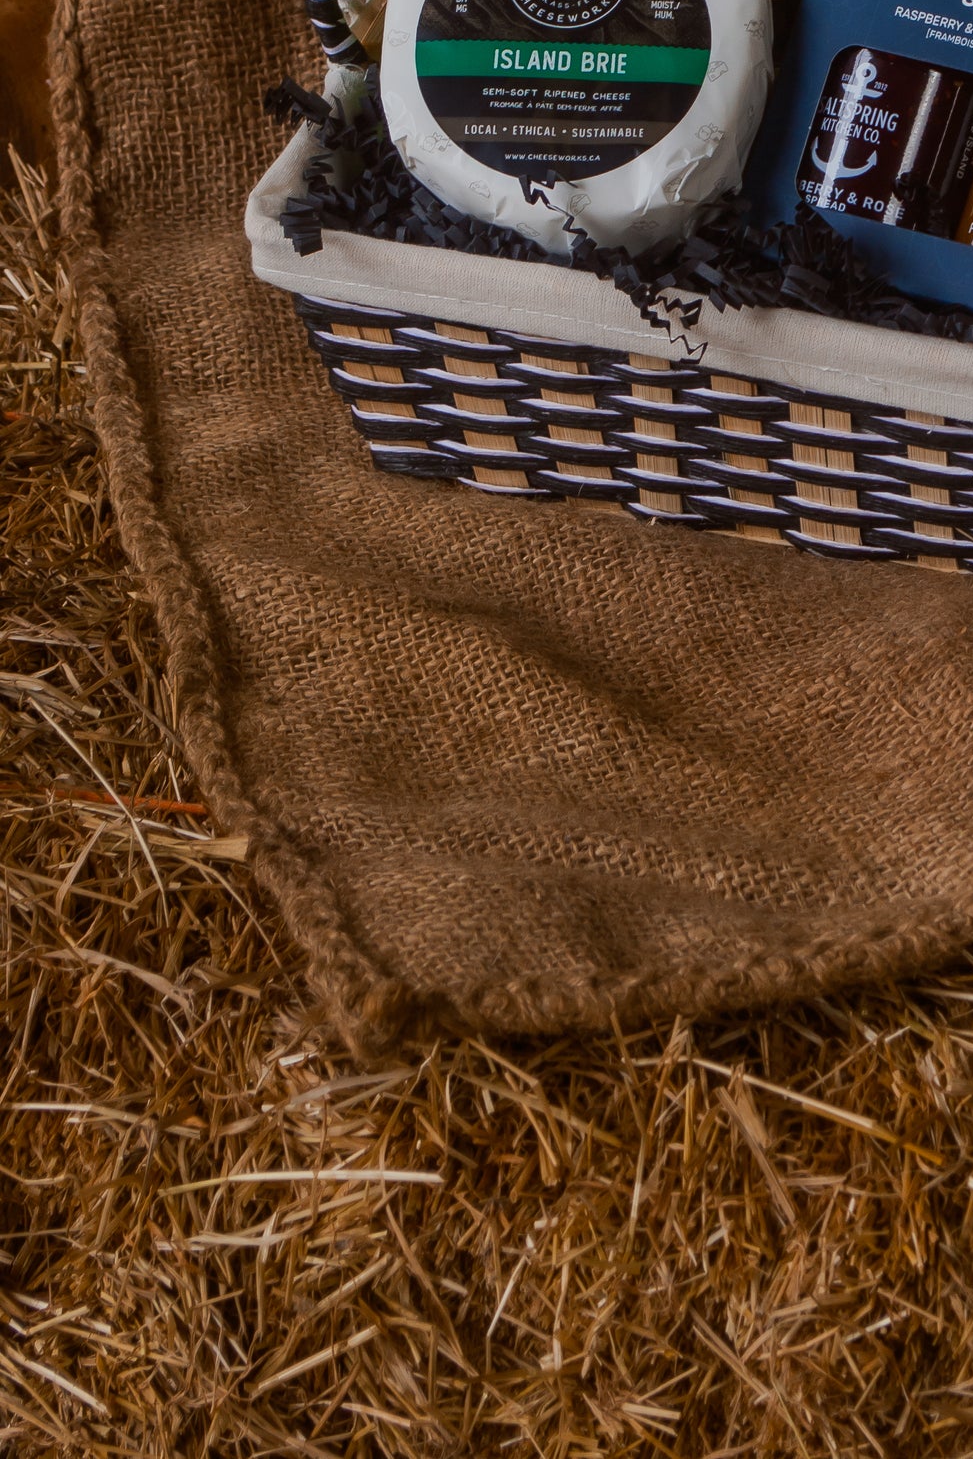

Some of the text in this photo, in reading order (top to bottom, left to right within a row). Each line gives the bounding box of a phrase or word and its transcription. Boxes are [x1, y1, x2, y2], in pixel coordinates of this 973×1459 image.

[456, 4, 468, 13] MG
[654, 10, 675, 19] HUM.
[894, 6, 964, 33] RASPBERRY
[493, 48, 628, 74] ISLAND BRIE
[874, 81, 888, 91] 2012
[482, 87, 631, 101] SEMI-SOFT RIPENED CHEESE
[489, 101, 524, 109] FROMAGE
[464, 124, 645, 138] LOCAL ETHICAL SUSTAINABLE
[864, 127, 881, 145] CO.
[504, 153, 601, 162] WWW.CHEESEWORKS.CA
[956, 136, 973, 180] ISLAND
[847, 191, 859, 206] &
